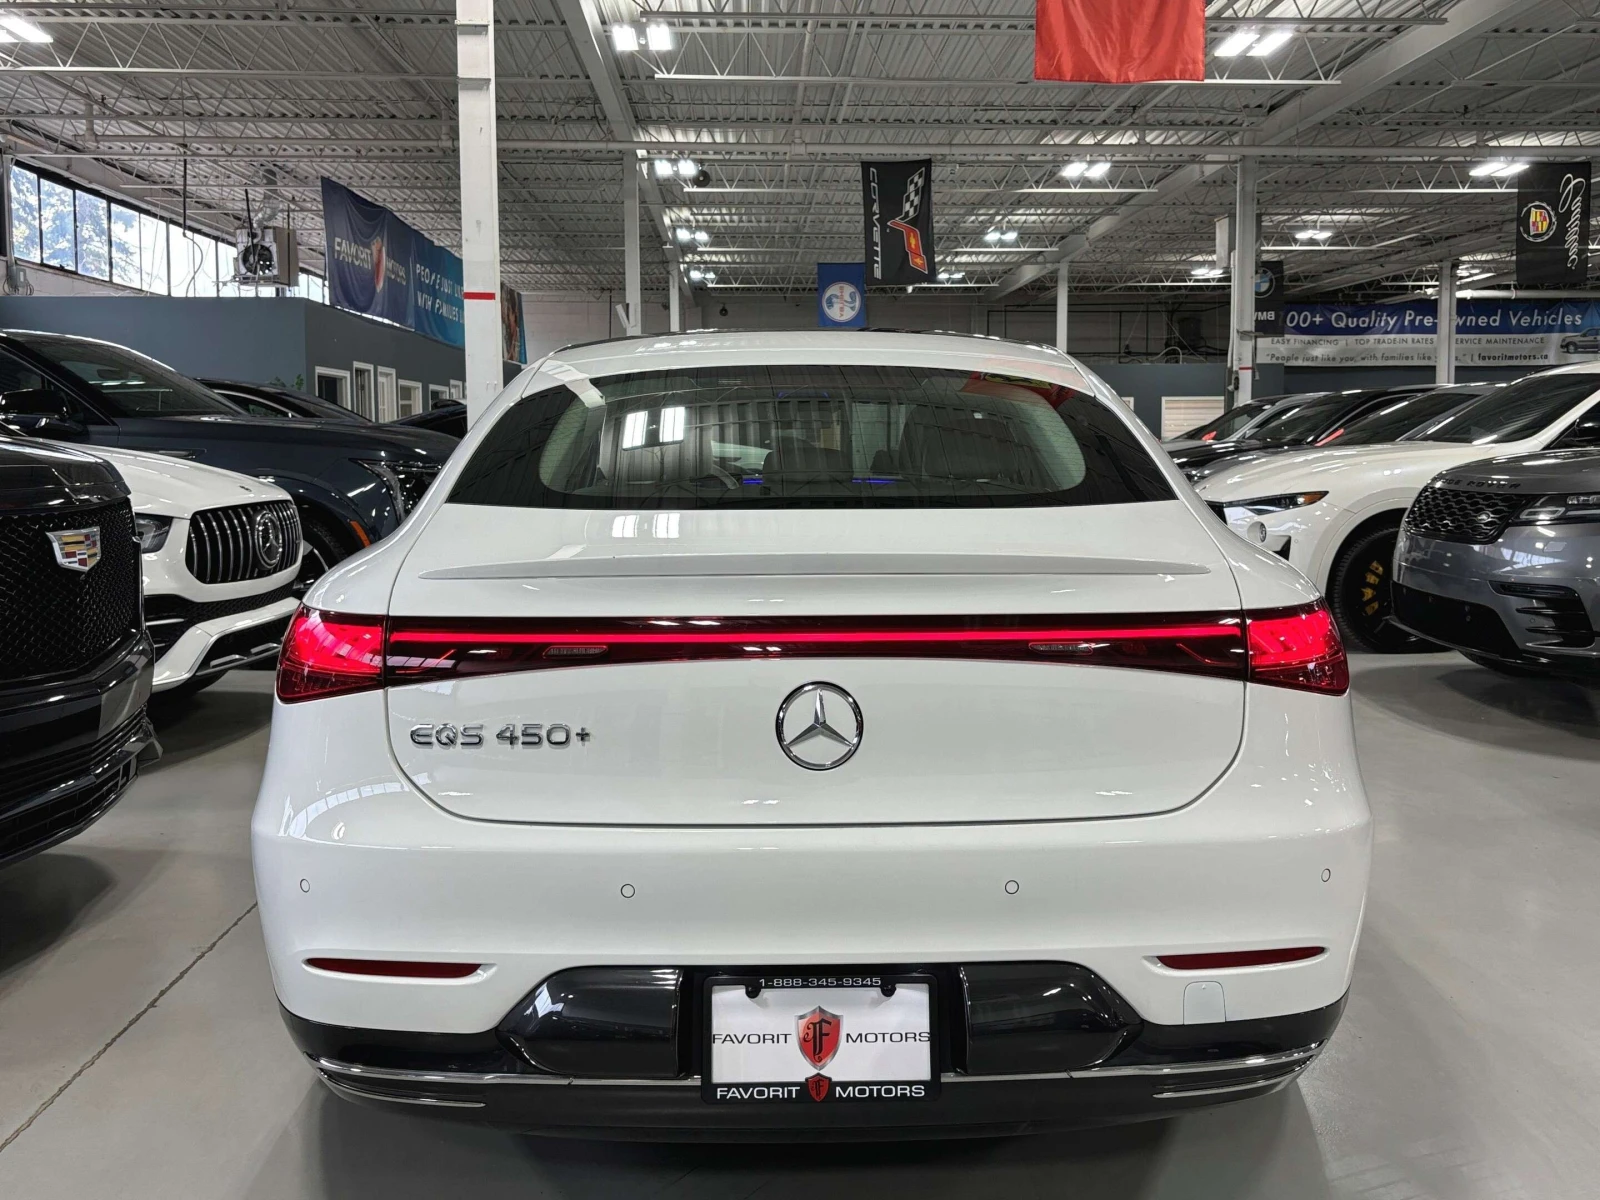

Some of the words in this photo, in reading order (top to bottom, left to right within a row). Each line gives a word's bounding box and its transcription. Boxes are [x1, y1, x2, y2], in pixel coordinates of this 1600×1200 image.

[869, 166, 882, 280] CORVETTE
[334, 237, 372, 270] FAVORIT
[415, 264, 441, 289] PEOE
[1280, 310, 1324, 328] 00+
[1331, 310, 1398, 331] Quality
[1404, 309, 1501, 327] Pre-wned
[1509, 308, 1584, 327] Vehicles
[1271, 337, 1291, 345] EASY
[1293, 338, 1339, 346] FINANCING
[1373, 337, 1408, 345] TRADE-IN
[1411, 337, 1434, 345] RATES
[1454, 337, 1482, 345] ERVICE
[1485, 337, 1545, 345] MAINTENANCE
[1302, 354, 1319, 363] just
[1321, 353, 1337, 362] like
[1360, 352, 1378, 361] with
[1381, 352, 1414, 361] families
[1416, 352, 1432, 361] like
[1477, 353, 1549, 361] favoritmotors.ca
[410, 723, 485, 749] EQS
[495, 723, 591, 749] 450+
[759, 978, 882, 987] 1-888-345-9345
[712, 1033, 792, 1044] FAVORIT
[845, 1031, 932, 1044] MOTORS
[716, 1086, 800, 1099] FAVORIT
[835, 1085, 925, 1098] MOTORS
